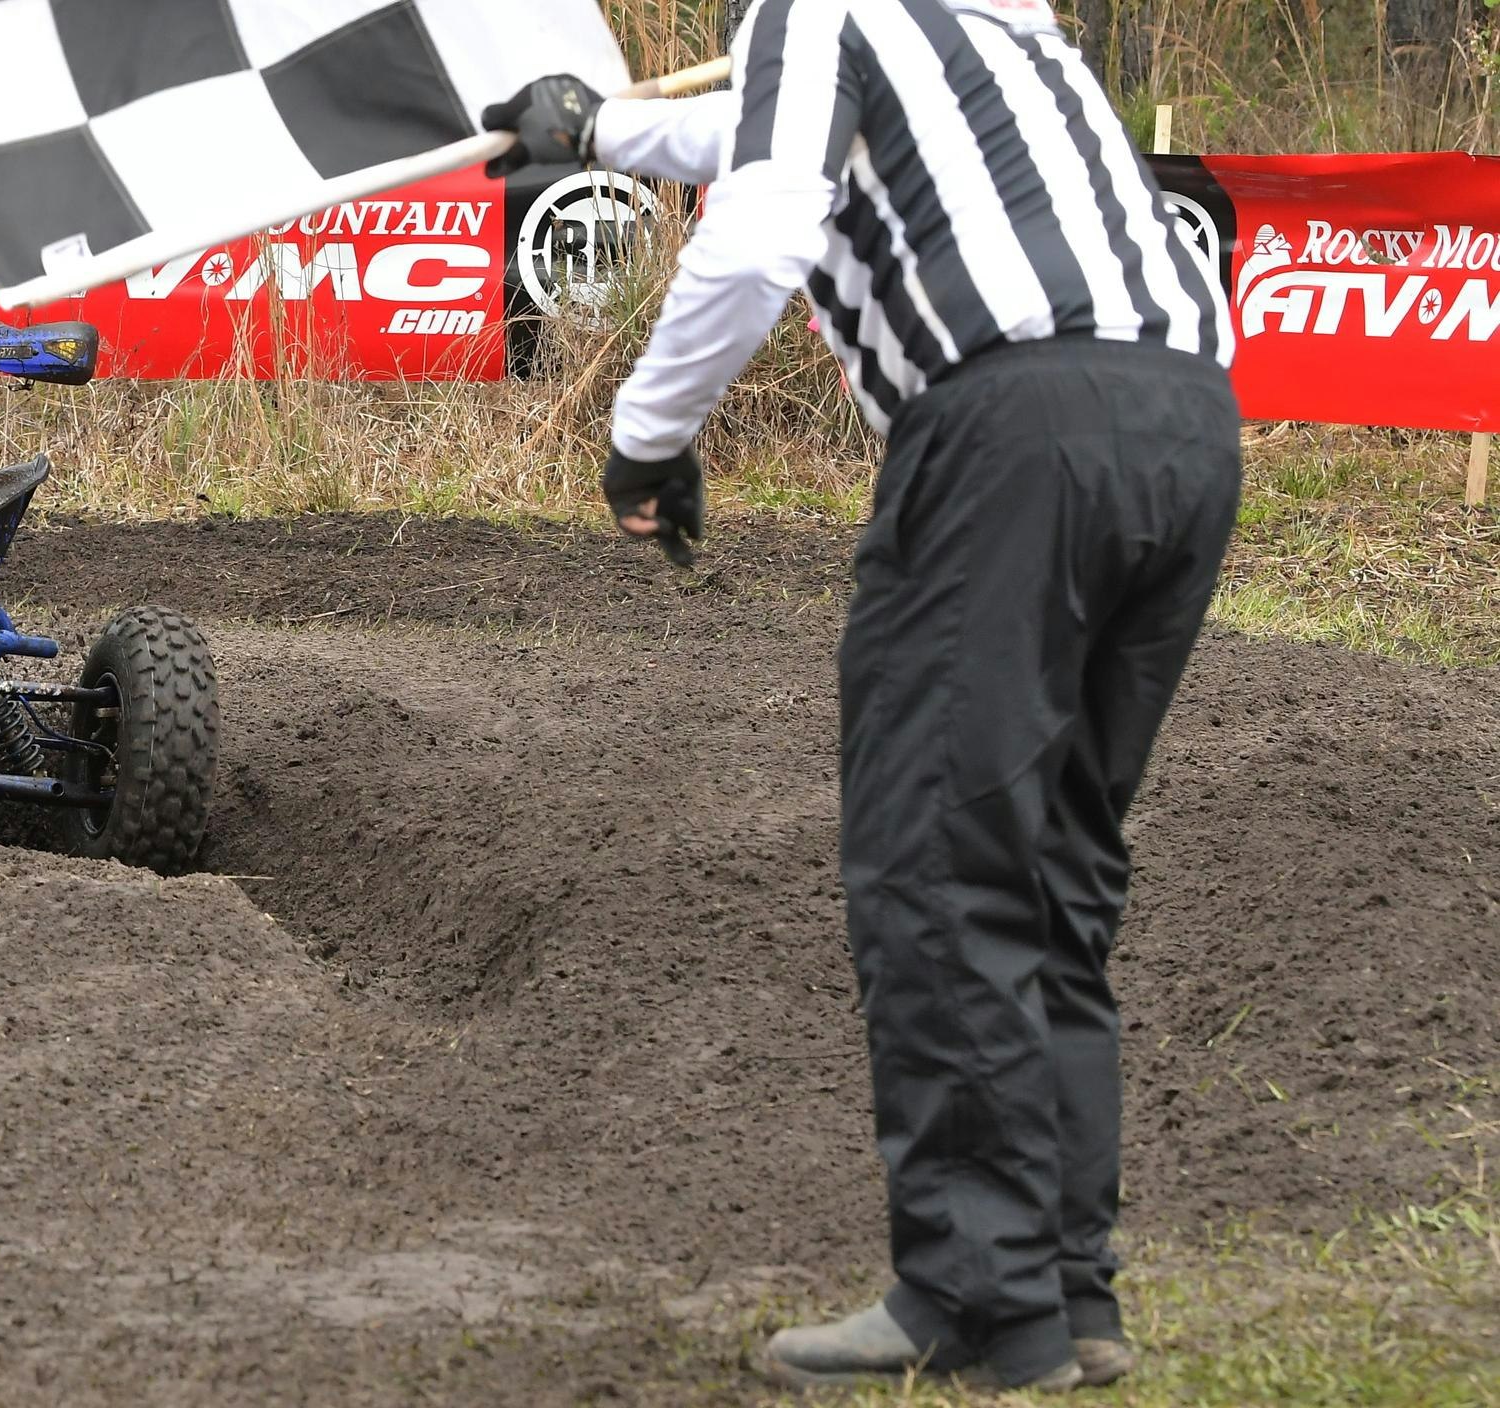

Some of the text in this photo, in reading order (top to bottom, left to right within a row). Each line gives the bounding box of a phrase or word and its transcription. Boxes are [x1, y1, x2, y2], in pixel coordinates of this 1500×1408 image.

[268, 201, 493, 236] UNTAIN
[1296, 219, 1500, 272] ROCKY MO
